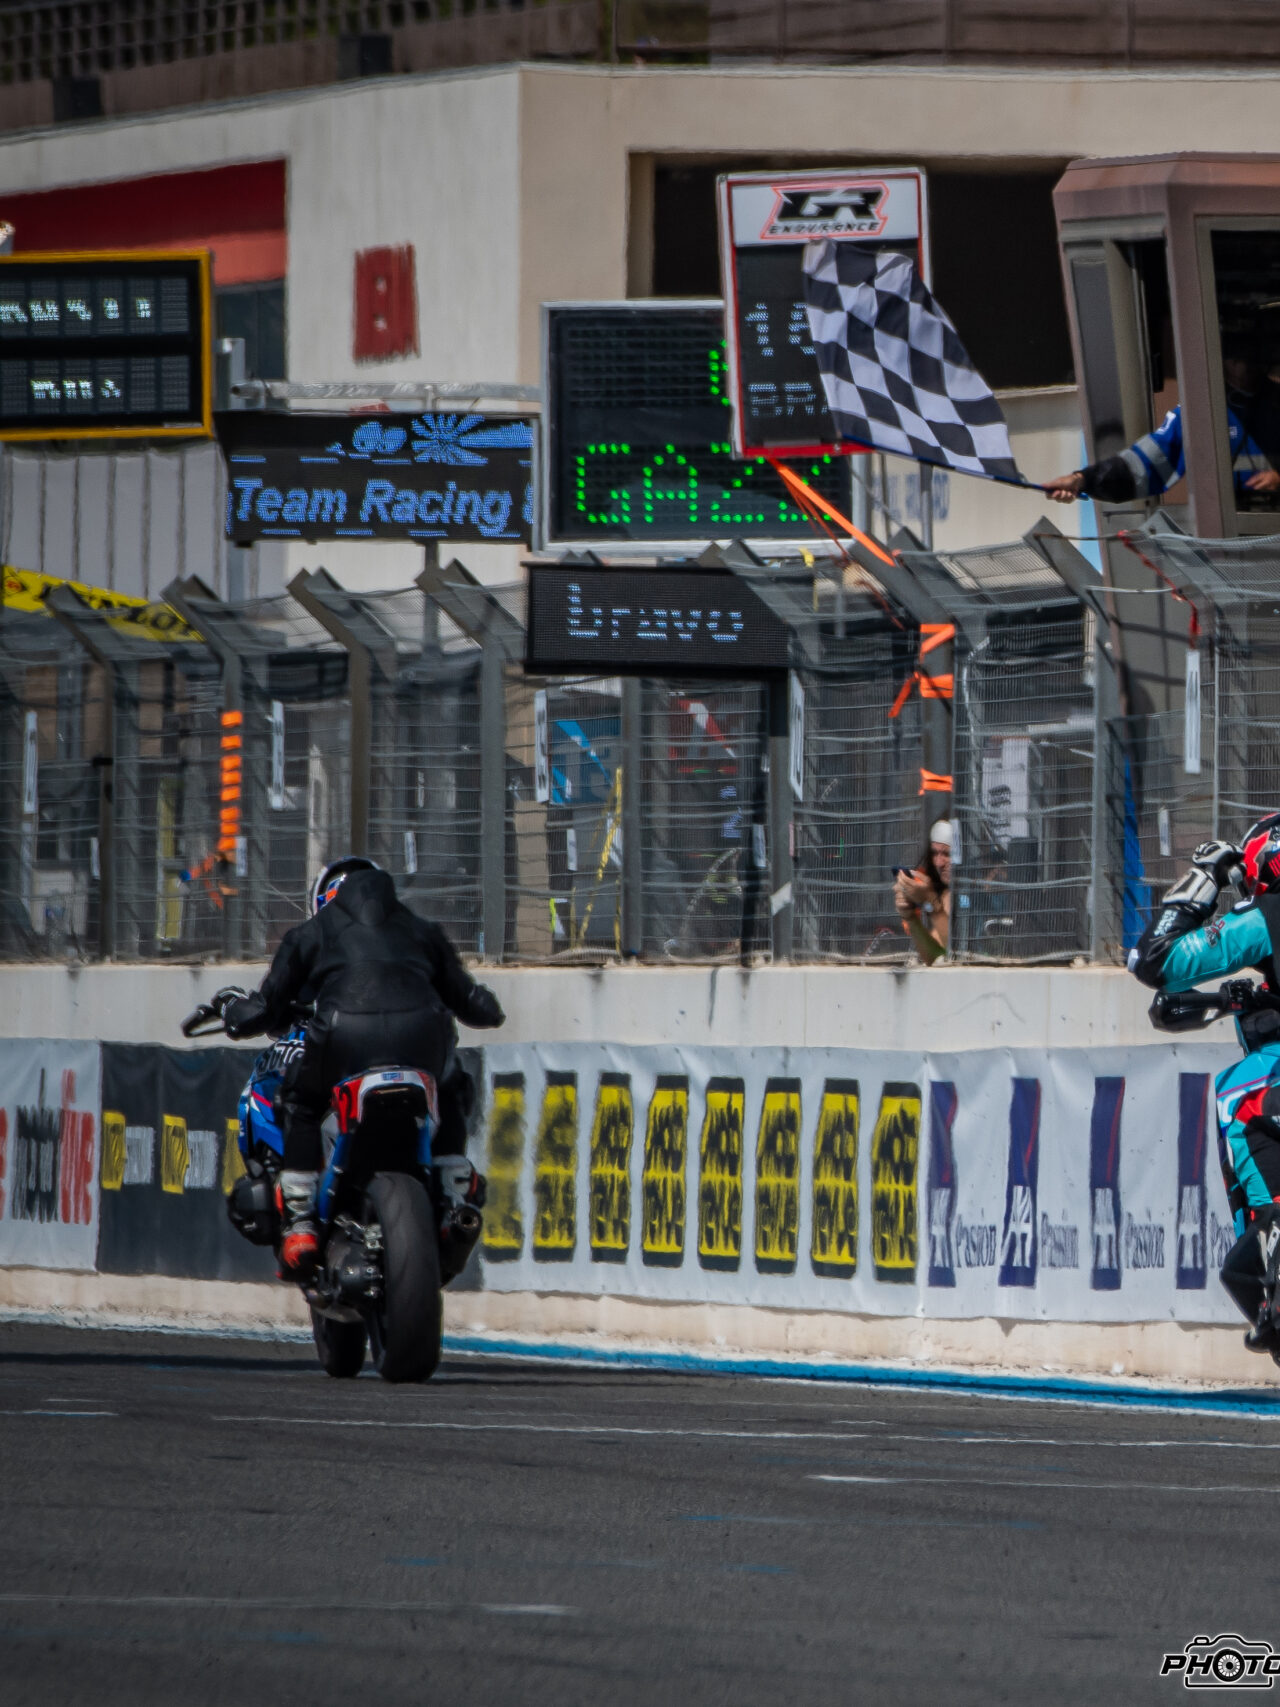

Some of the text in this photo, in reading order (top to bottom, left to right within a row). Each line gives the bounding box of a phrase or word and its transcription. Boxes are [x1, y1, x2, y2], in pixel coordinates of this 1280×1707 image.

[768, 221, 880, 234] ENDURANCE
[233, 477, 513, 537] Team Racing
[567, 582, 745, 642] bravo
